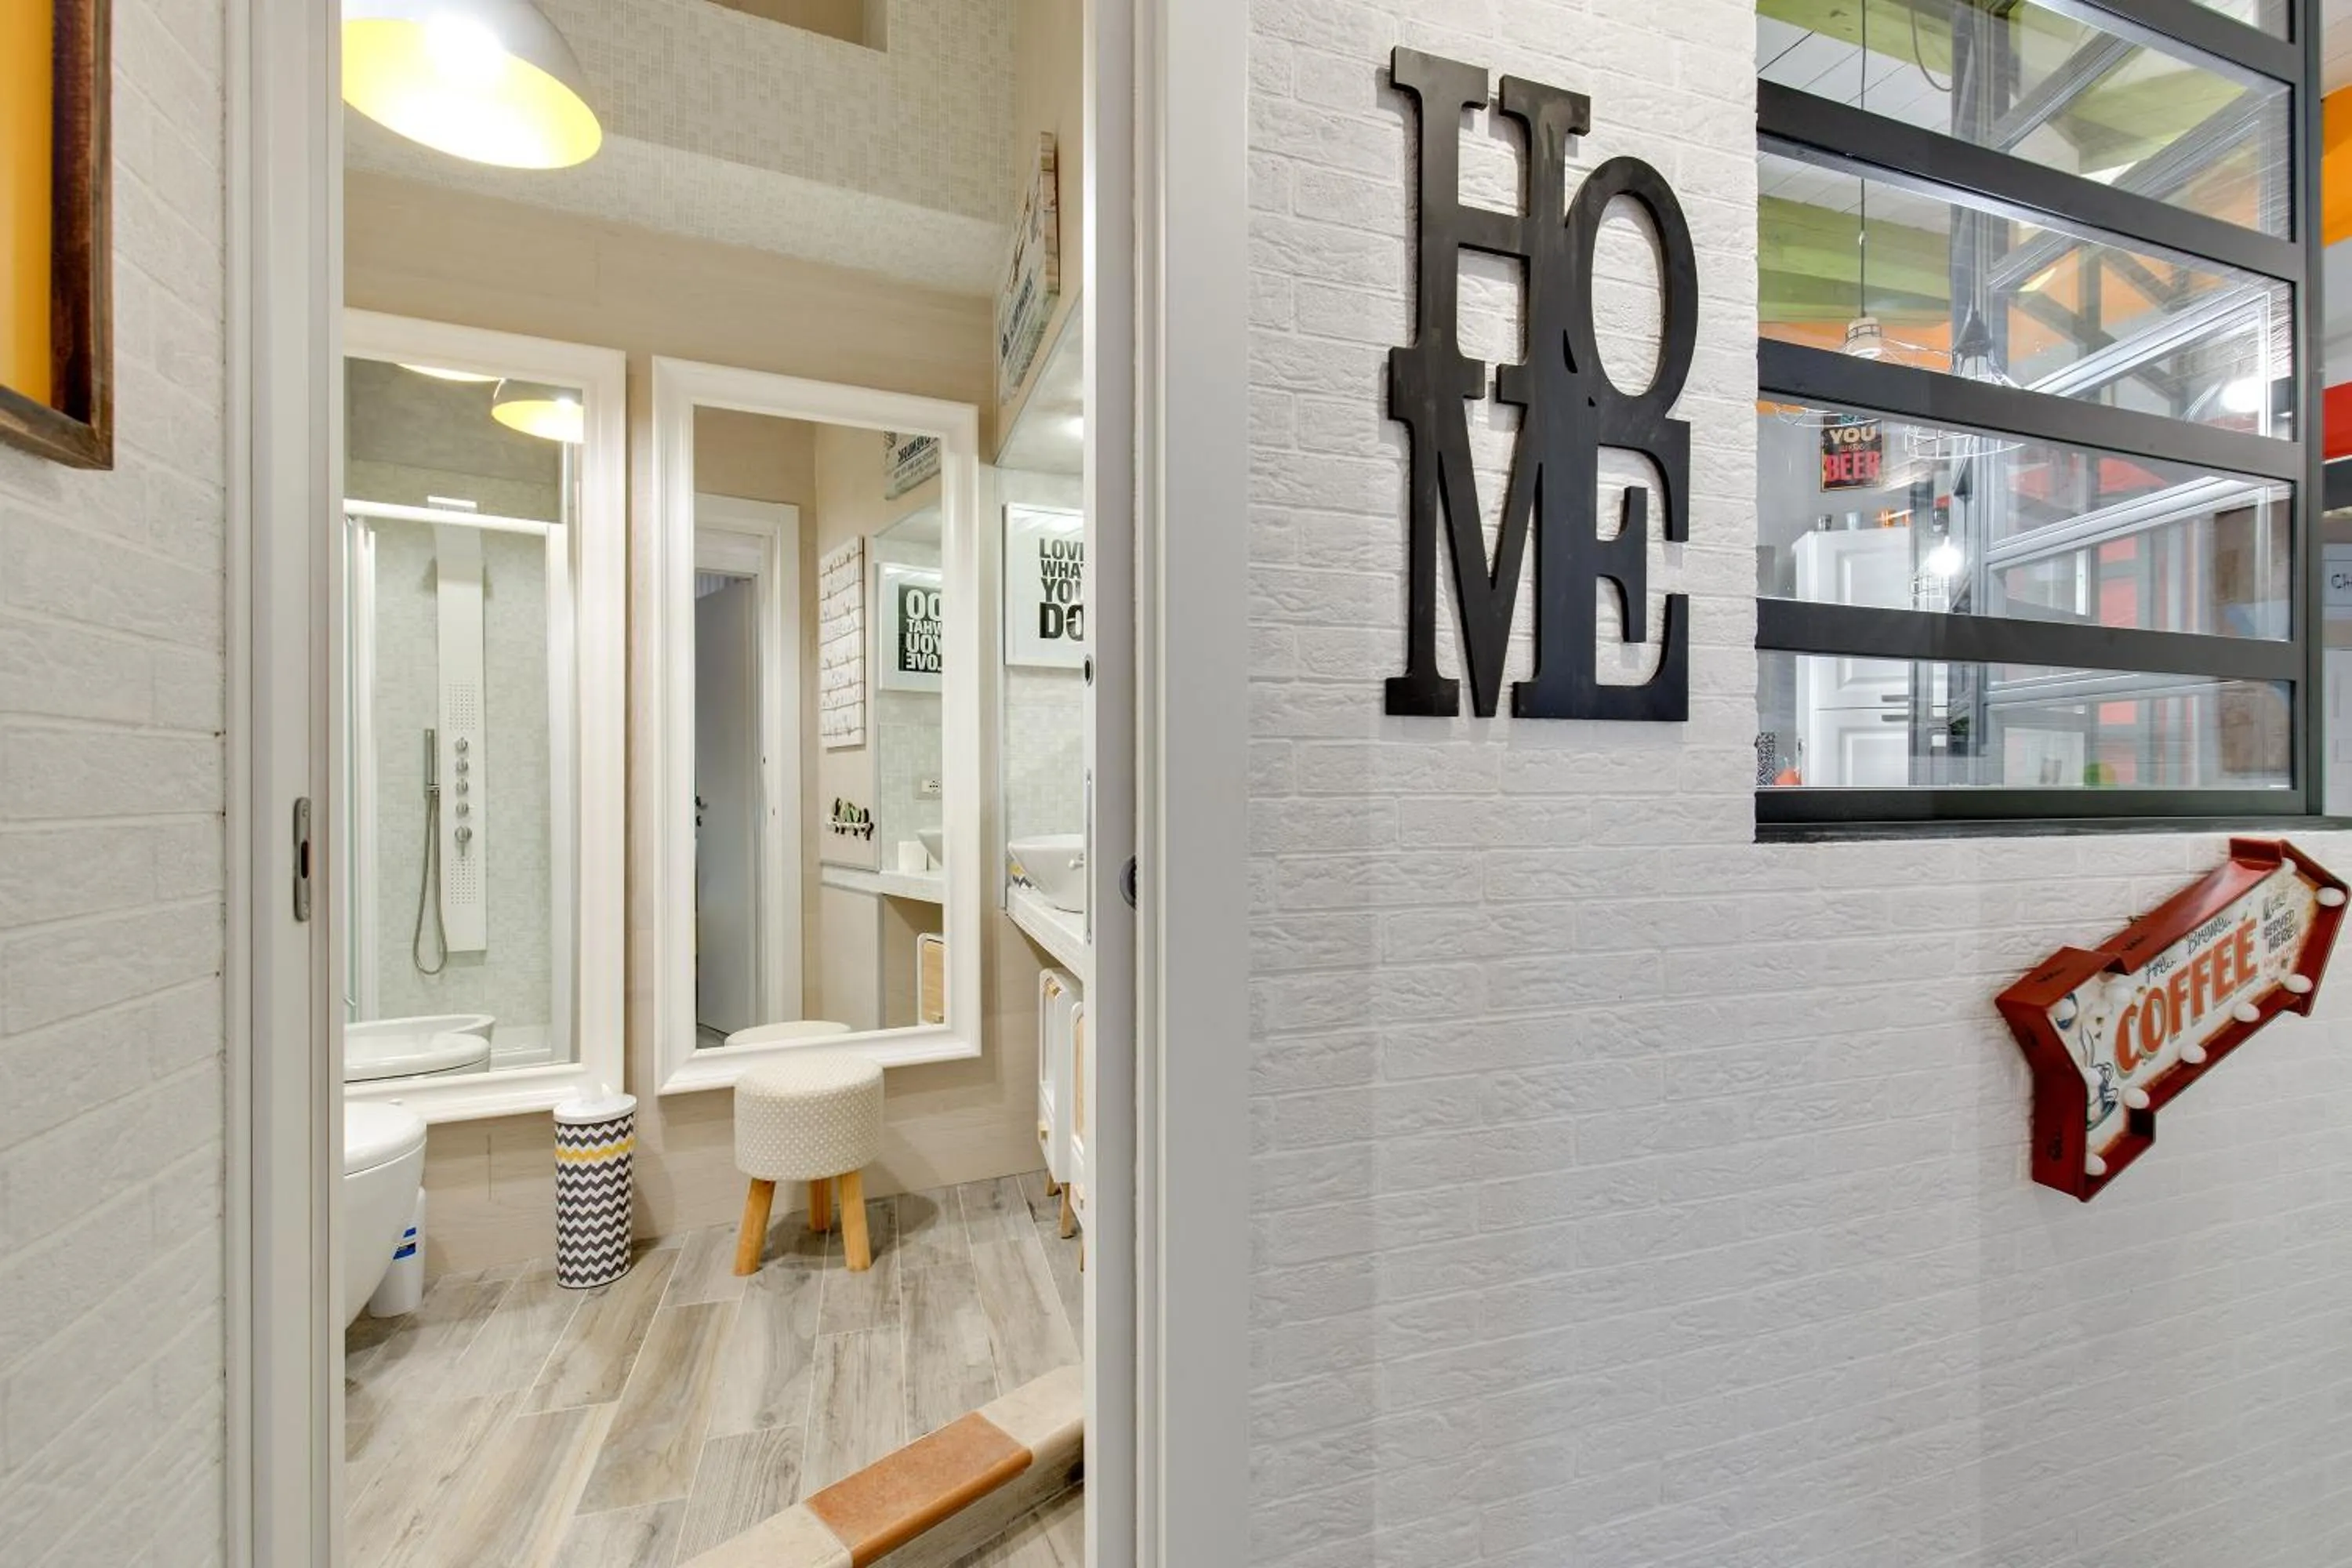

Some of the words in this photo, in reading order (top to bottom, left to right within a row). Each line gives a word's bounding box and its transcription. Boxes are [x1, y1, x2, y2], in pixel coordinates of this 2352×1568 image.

[1829, 425, 1877, 445] YOU
[1824, 451, 1880, 481] BEER
[1040, 560, 1083, 579] WHA
[2114, 917, 2258, 1077] COFFEE
